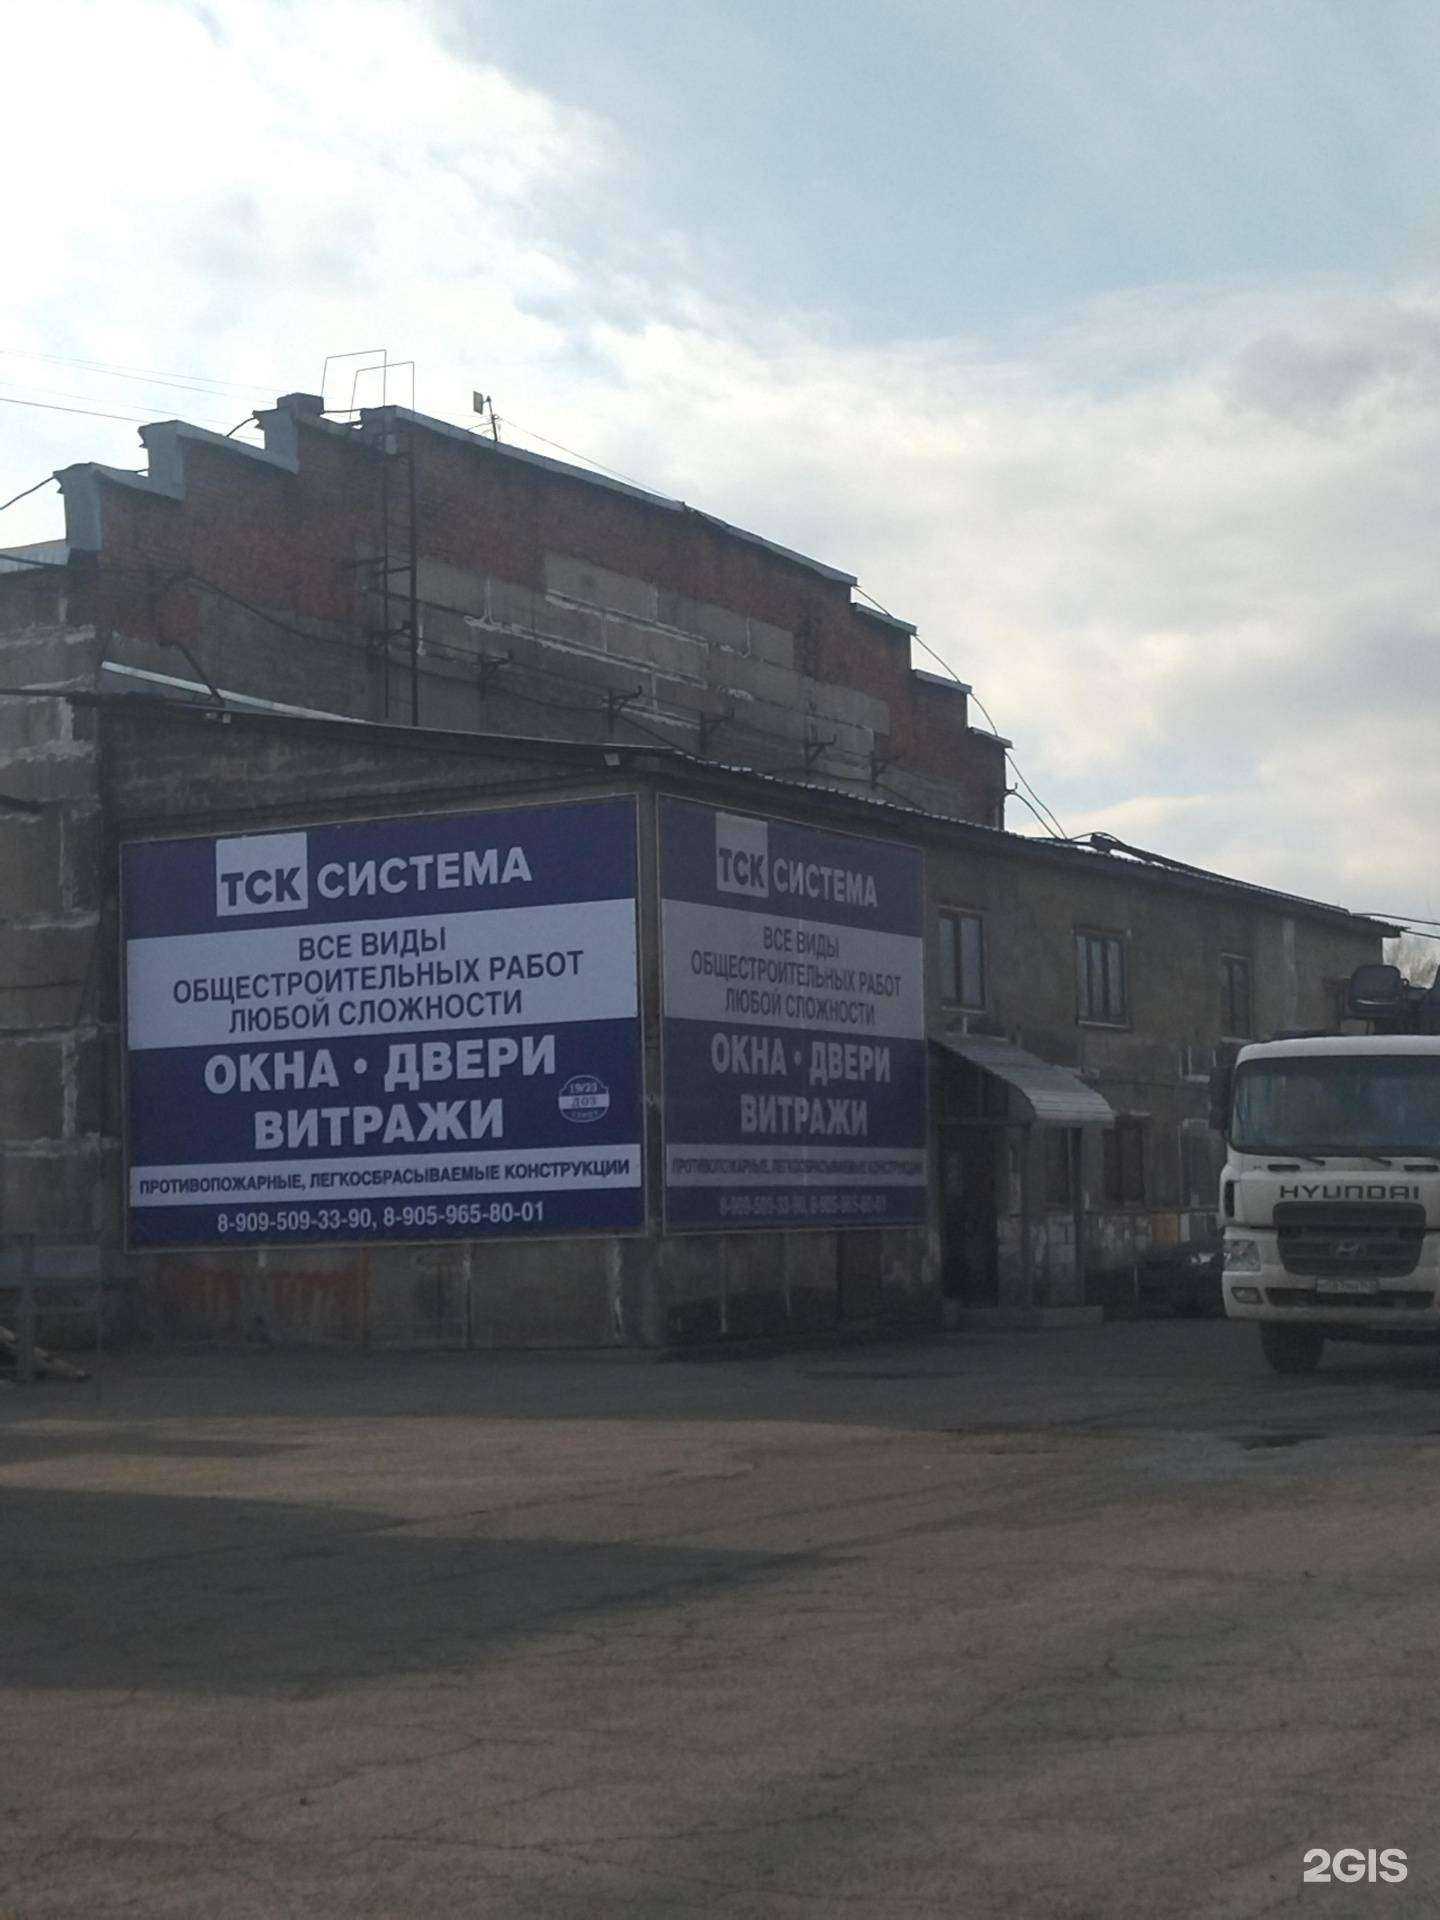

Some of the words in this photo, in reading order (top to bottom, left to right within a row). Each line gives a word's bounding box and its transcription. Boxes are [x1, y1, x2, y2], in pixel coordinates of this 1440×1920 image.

[220, 866, 304, 907] ТСК
[317, 846, 532, 899] СИСТЕМА
[719, 848, 767, 889] ТСК
[773, 857, 879, 908] СИСТЕМА
[299, 933, 352, 962] ВСЕ
[361, 926, 447, 958] ВИДЫ
[763, 925, 793, 952] ВСЕ
[796, 931, 840, 961] ВИДЫ
[173, 958, 480, 1005] ОБЩЕСТРОИТЕЛЬНЫХ
[489, 949, 585, 982] РАБОТ
[690, 949, 855, 993] ОБЩЕСТРОИТЕЛЬНЫХ
[859, 971, 902, 998] РАБОТ
[229, 996, 330, 1034] ЛЮБОЙ
[338, 989, 523, 1025] СЛОЖНОСТИ
[725, 986, 782, 1016] ЛЮБОЙ
[785, 994, 876, 1026] СЛОЖНОСТИ
[204, 1048, 340, 1094] ОКНА
[384, 1034, 556, 1092] ДВЕРИ
[710, 1032, 788, 1076] ОКНА
[808, 1041, 891, 1087] ДВЕРИ
[254, 1098, 504, 1150] ВИТРАЖИ
[740, 1093, 868, 1137] ВИТРАЖИ
[139, 1174, 306, 1195] ПРОТИВОПОЖАРНЫЕ,
[309, 1164, 500, 1189] ЛЕГКОСБРАСЫВАЕМЫЕ
[504, 1158, 630, 1180] КОНСТРУКЦИИ
[1279, 1184, 1420, 1200] HYUNDAI
[217, 1207, 378, 1232] 8-909-509-33-90,
[383, 1201, 545, 1227] 8-905-965-80-01
